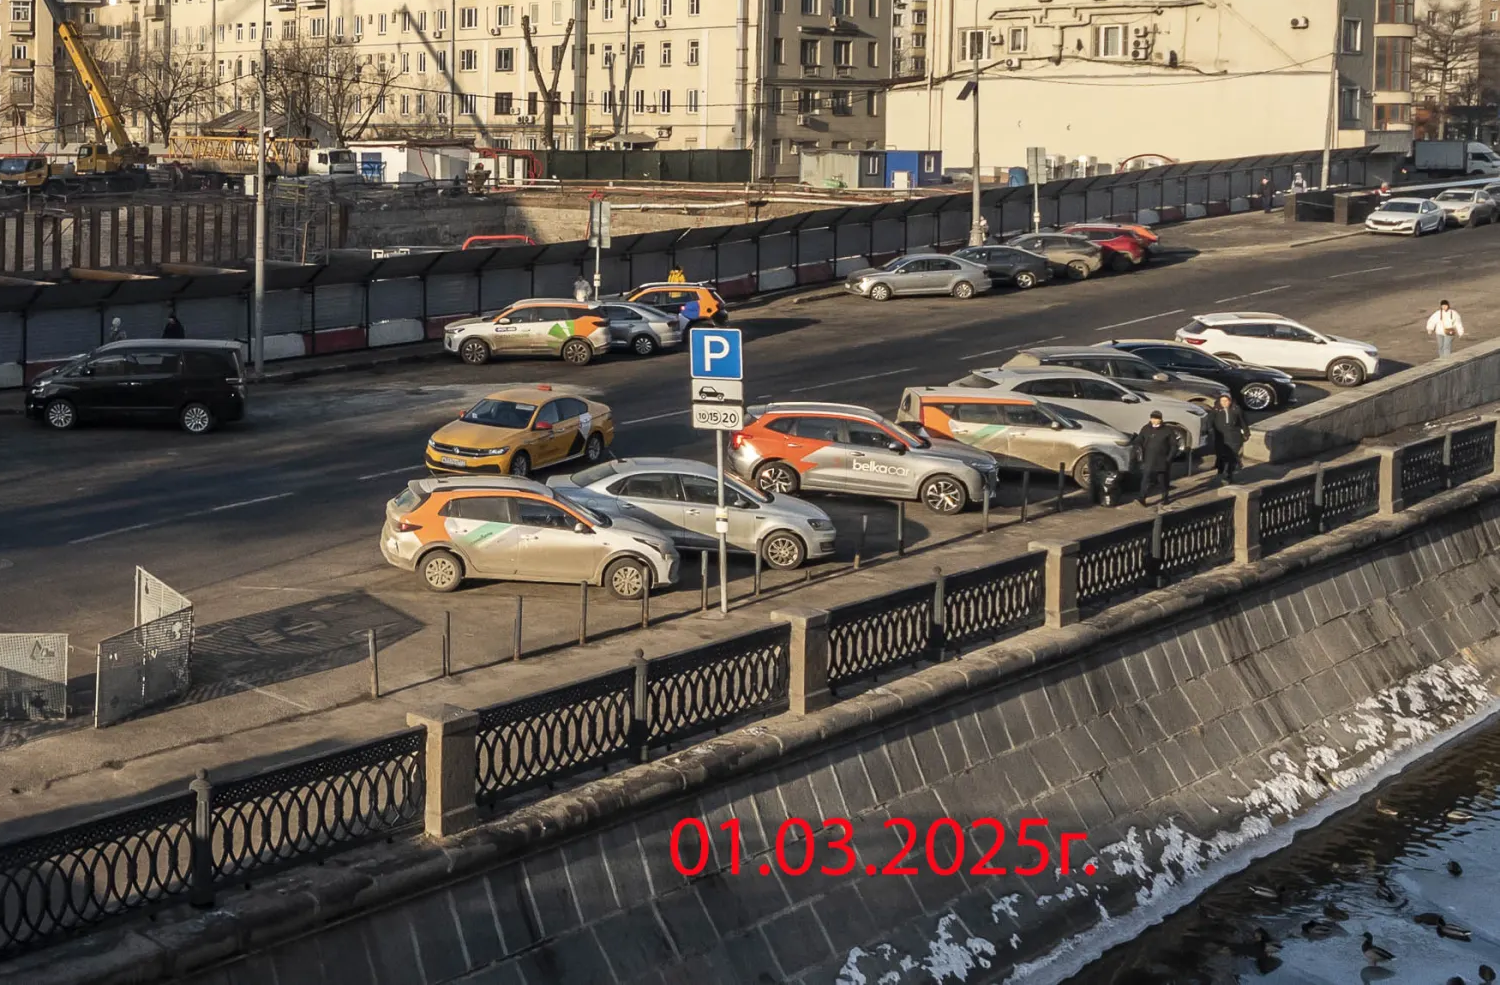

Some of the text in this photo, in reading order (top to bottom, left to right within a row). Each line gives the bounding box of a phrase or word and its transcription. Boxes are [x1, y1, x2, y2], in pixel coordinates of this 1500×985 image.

[704, 335, 730, 372] P
[698, 412, 737, 423] 10 15 20
[852, 458, 910, 477] belkacar
